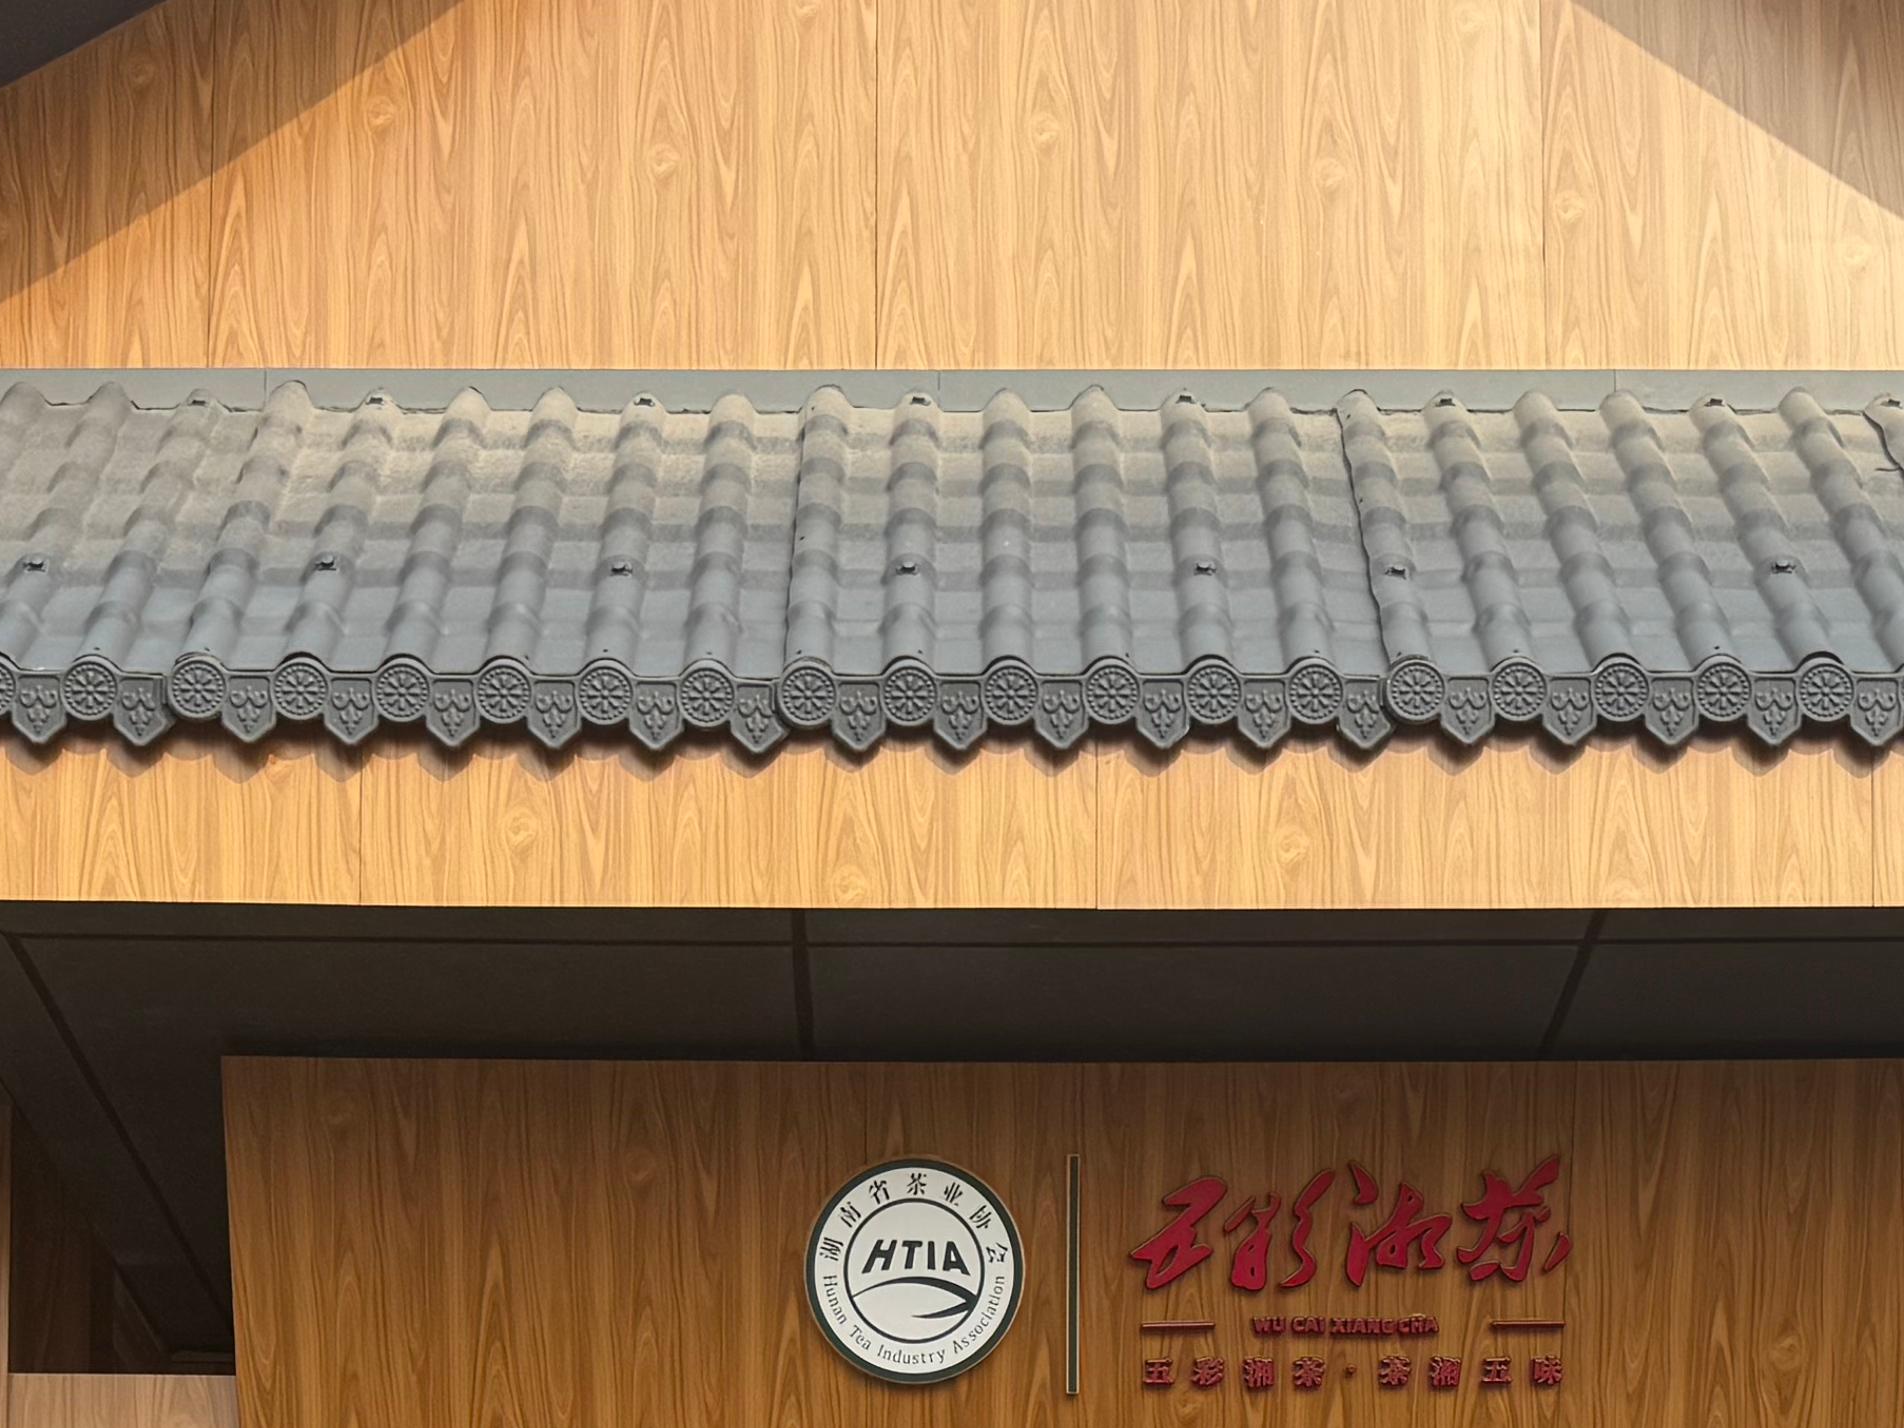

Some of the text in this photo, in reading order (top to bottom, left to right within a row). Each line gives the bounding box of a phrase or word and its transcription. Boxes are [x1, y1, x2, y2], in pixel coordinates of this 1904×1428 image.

[819, 1172, 1009, 1264] 湖南省茶业协会
[862, 1239, 971, 1276] HTIA
[823, 1274, 1006, 1365] Hunan Tea Industry Association
[1252, 1314, 1440, 1337] WU CAI XIANG CHA
